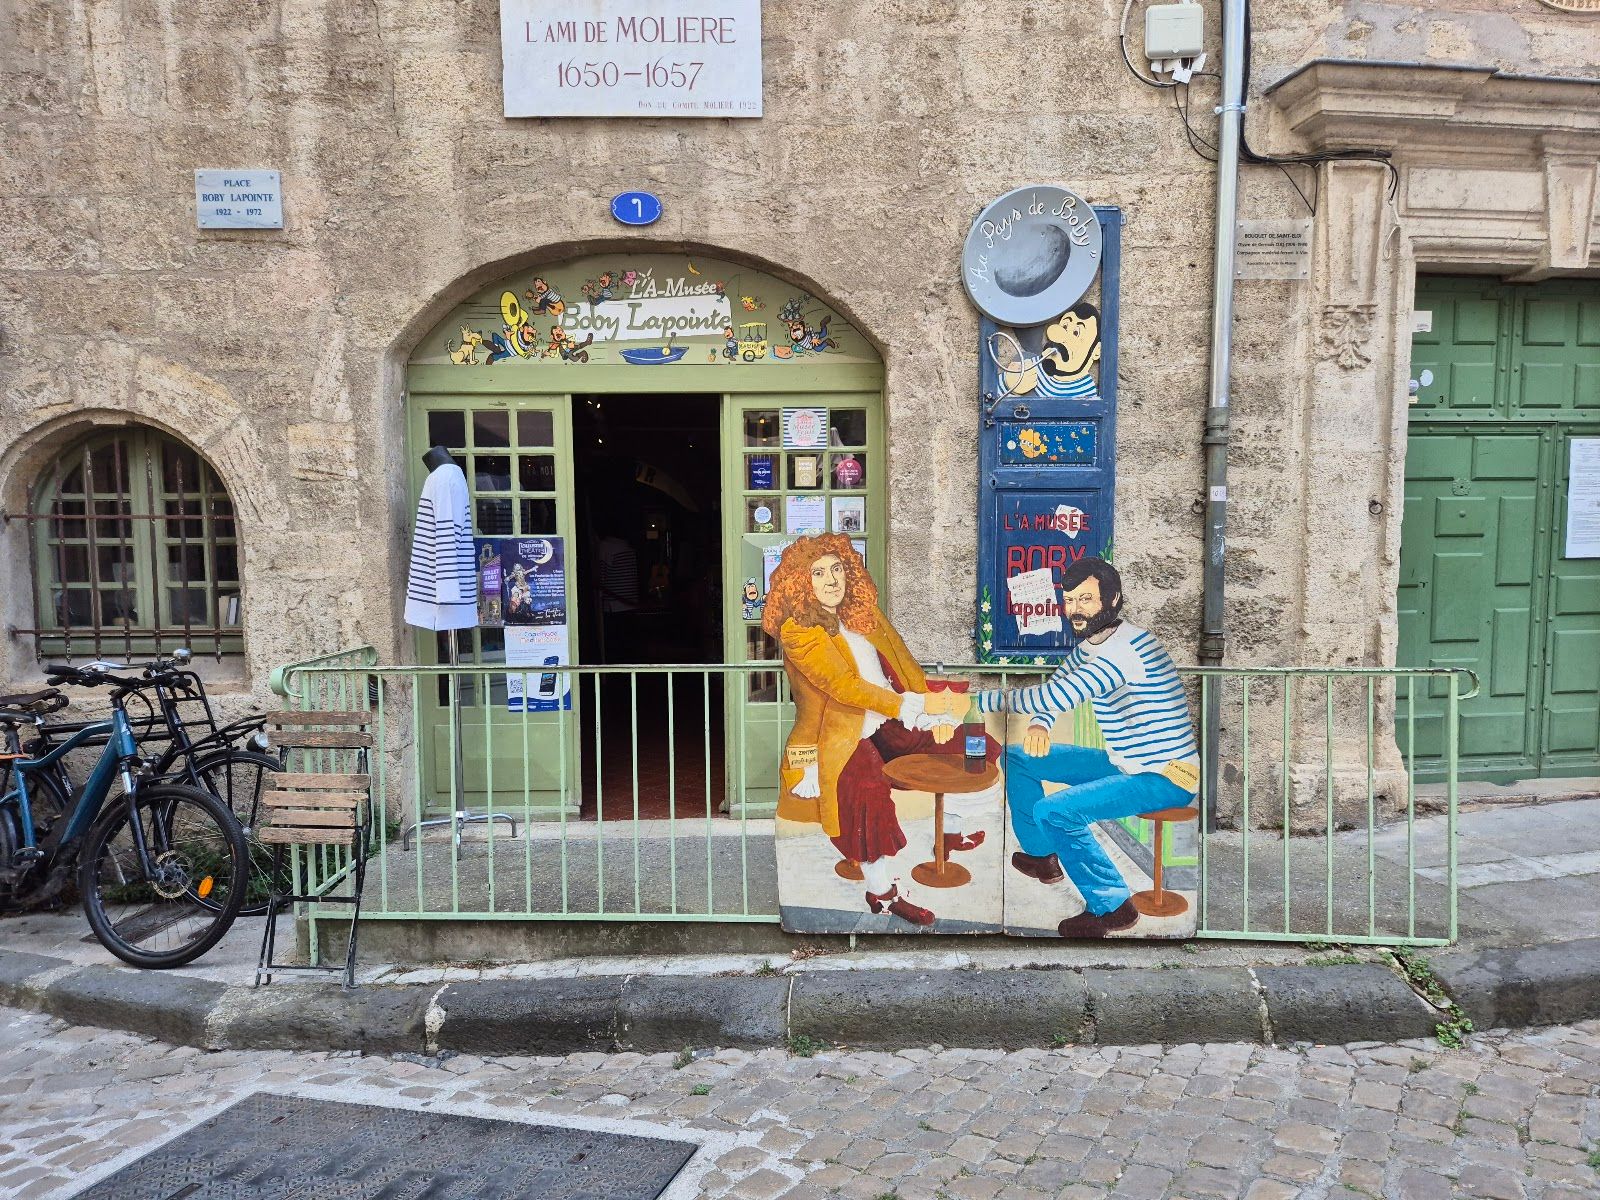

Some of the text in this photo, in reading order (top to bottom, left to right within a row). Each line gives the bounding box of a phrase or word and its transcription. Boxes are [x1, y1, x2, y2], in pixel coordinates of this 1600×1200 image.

[525, 17, 737, 45] L'AMI DE MOLIERE
[202, 194, 274, 202] BOBY LAPOINTE
[980, 208, 1023, 249] Pays
[1028, 193, 1046, 216] de
[562, 302, 732, 341] Boby Lapointe
[1439, 395, 1444, 404] 3
